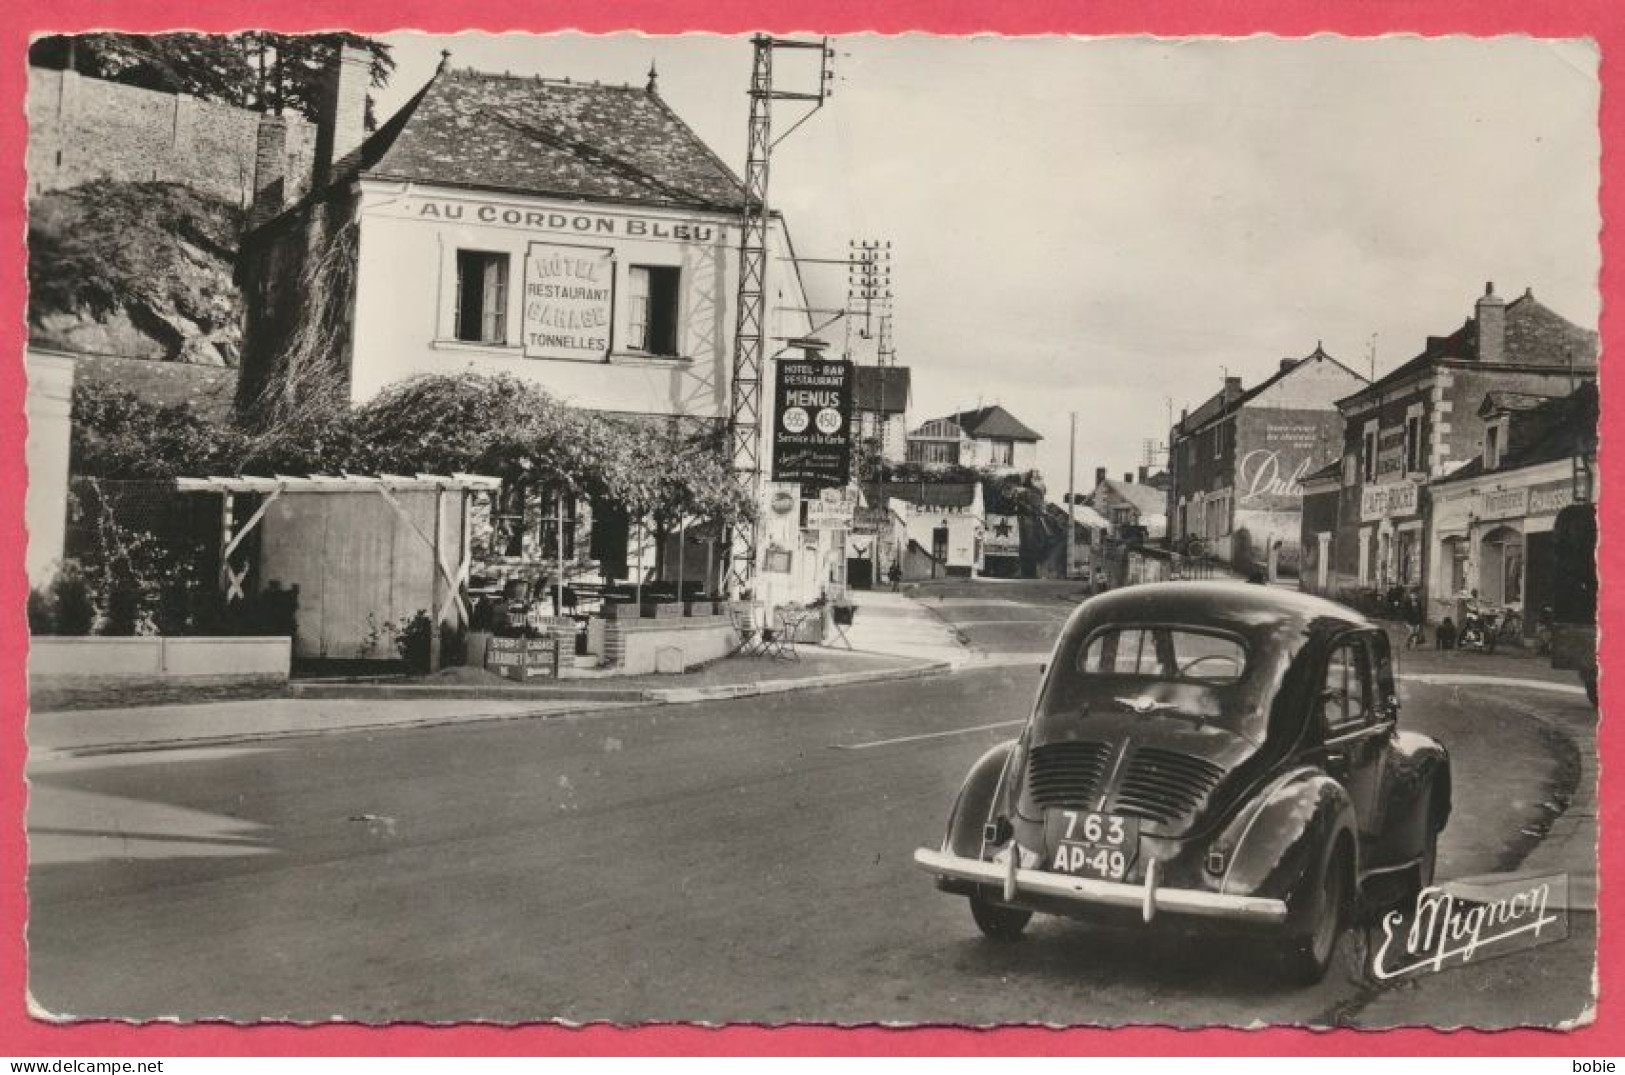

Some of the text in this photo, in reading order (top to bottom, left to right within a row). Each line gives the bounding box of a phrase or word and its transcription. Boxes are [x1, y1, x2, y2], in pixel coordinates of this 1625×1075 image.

[420, 202, 712, 241] AU CORDON BLEU
[527, 283, 609, 301] RESTAURANT
[528, 332, 605, 351] TONNELLES
[784, 375, 844, 386] RESTAURANT
[786, 389, 840, 407] MENUS
[1063, 810, 1125, 845] 763
[1052, 844, 1125, 879] AP-49
